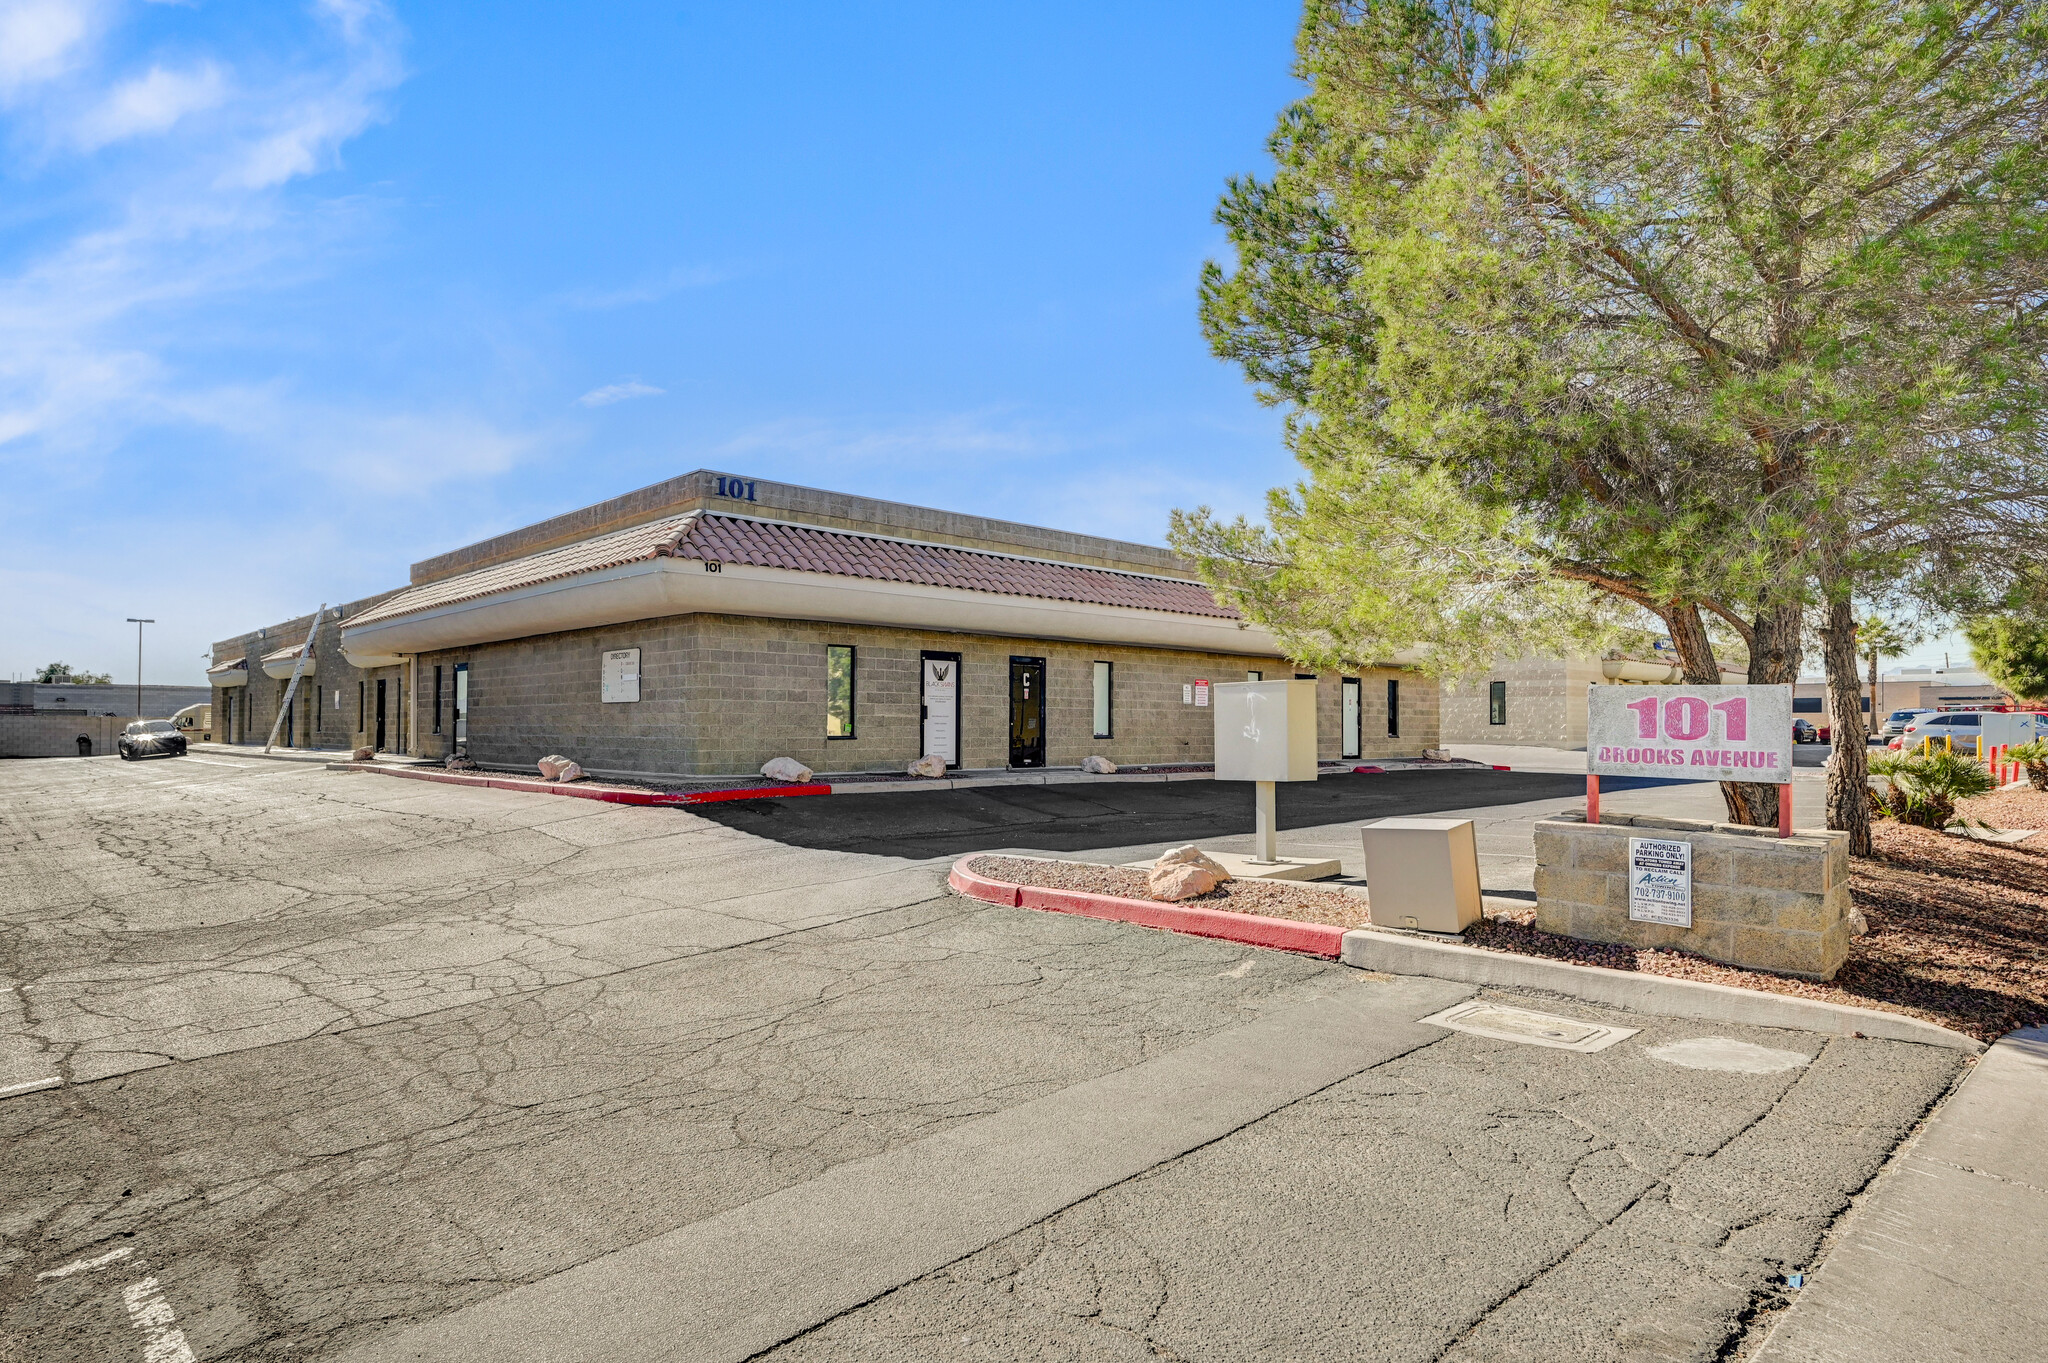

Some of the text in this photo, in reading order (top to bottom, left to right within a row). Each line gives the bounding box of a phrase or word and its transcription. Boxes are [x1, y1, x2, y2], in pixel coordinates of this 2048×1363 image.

[715, 477, 757, 501] 101
[705, 562, 721, 573] 101
[610, 652, 630, 660] DIRECTORY
[1023, 672, 1030, 687] C
[1626, 697, 1747, 741] 101
[1599, 746, 1779, 769] BROOKS AVENUE
[1640, 842, 1681, 852] AUTHORIZED
[1635, 849, 1685, 860] PARKING ONLY!
[1639, 873, 1678, 886] Action
[1634, 897, 1686, 907] www.actiontowing.net
